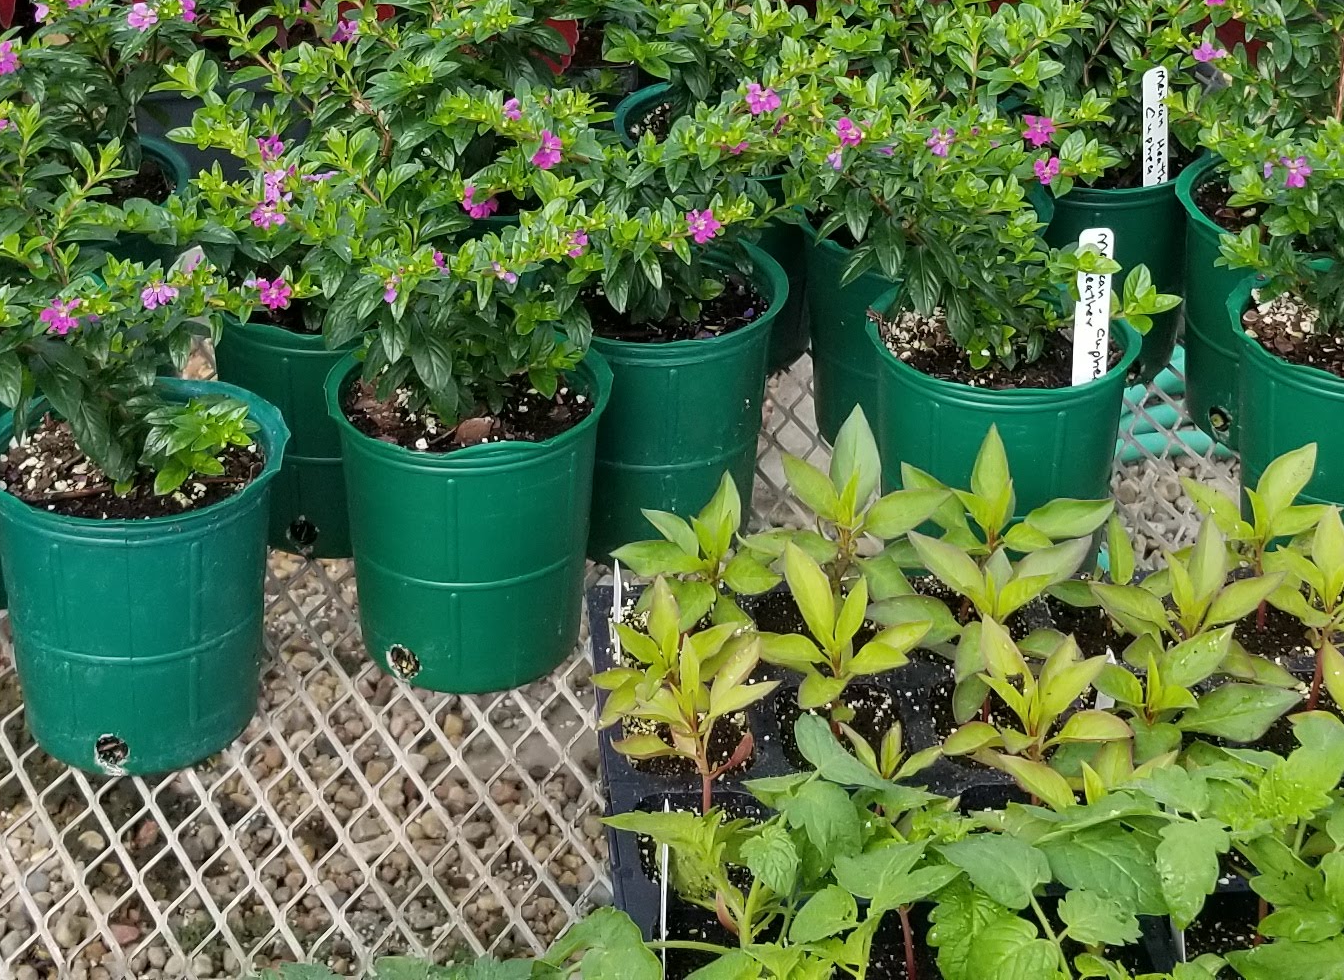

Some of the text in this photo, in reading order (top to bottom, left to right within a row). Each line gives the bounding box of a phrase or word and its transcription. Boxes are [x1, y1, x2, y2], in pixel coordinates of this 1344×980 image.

[1145, 107, 1156, 175] Cuphea
[1097, 233, 1108, 299] Mecan
[1085, 272, 1096, 327] eather
